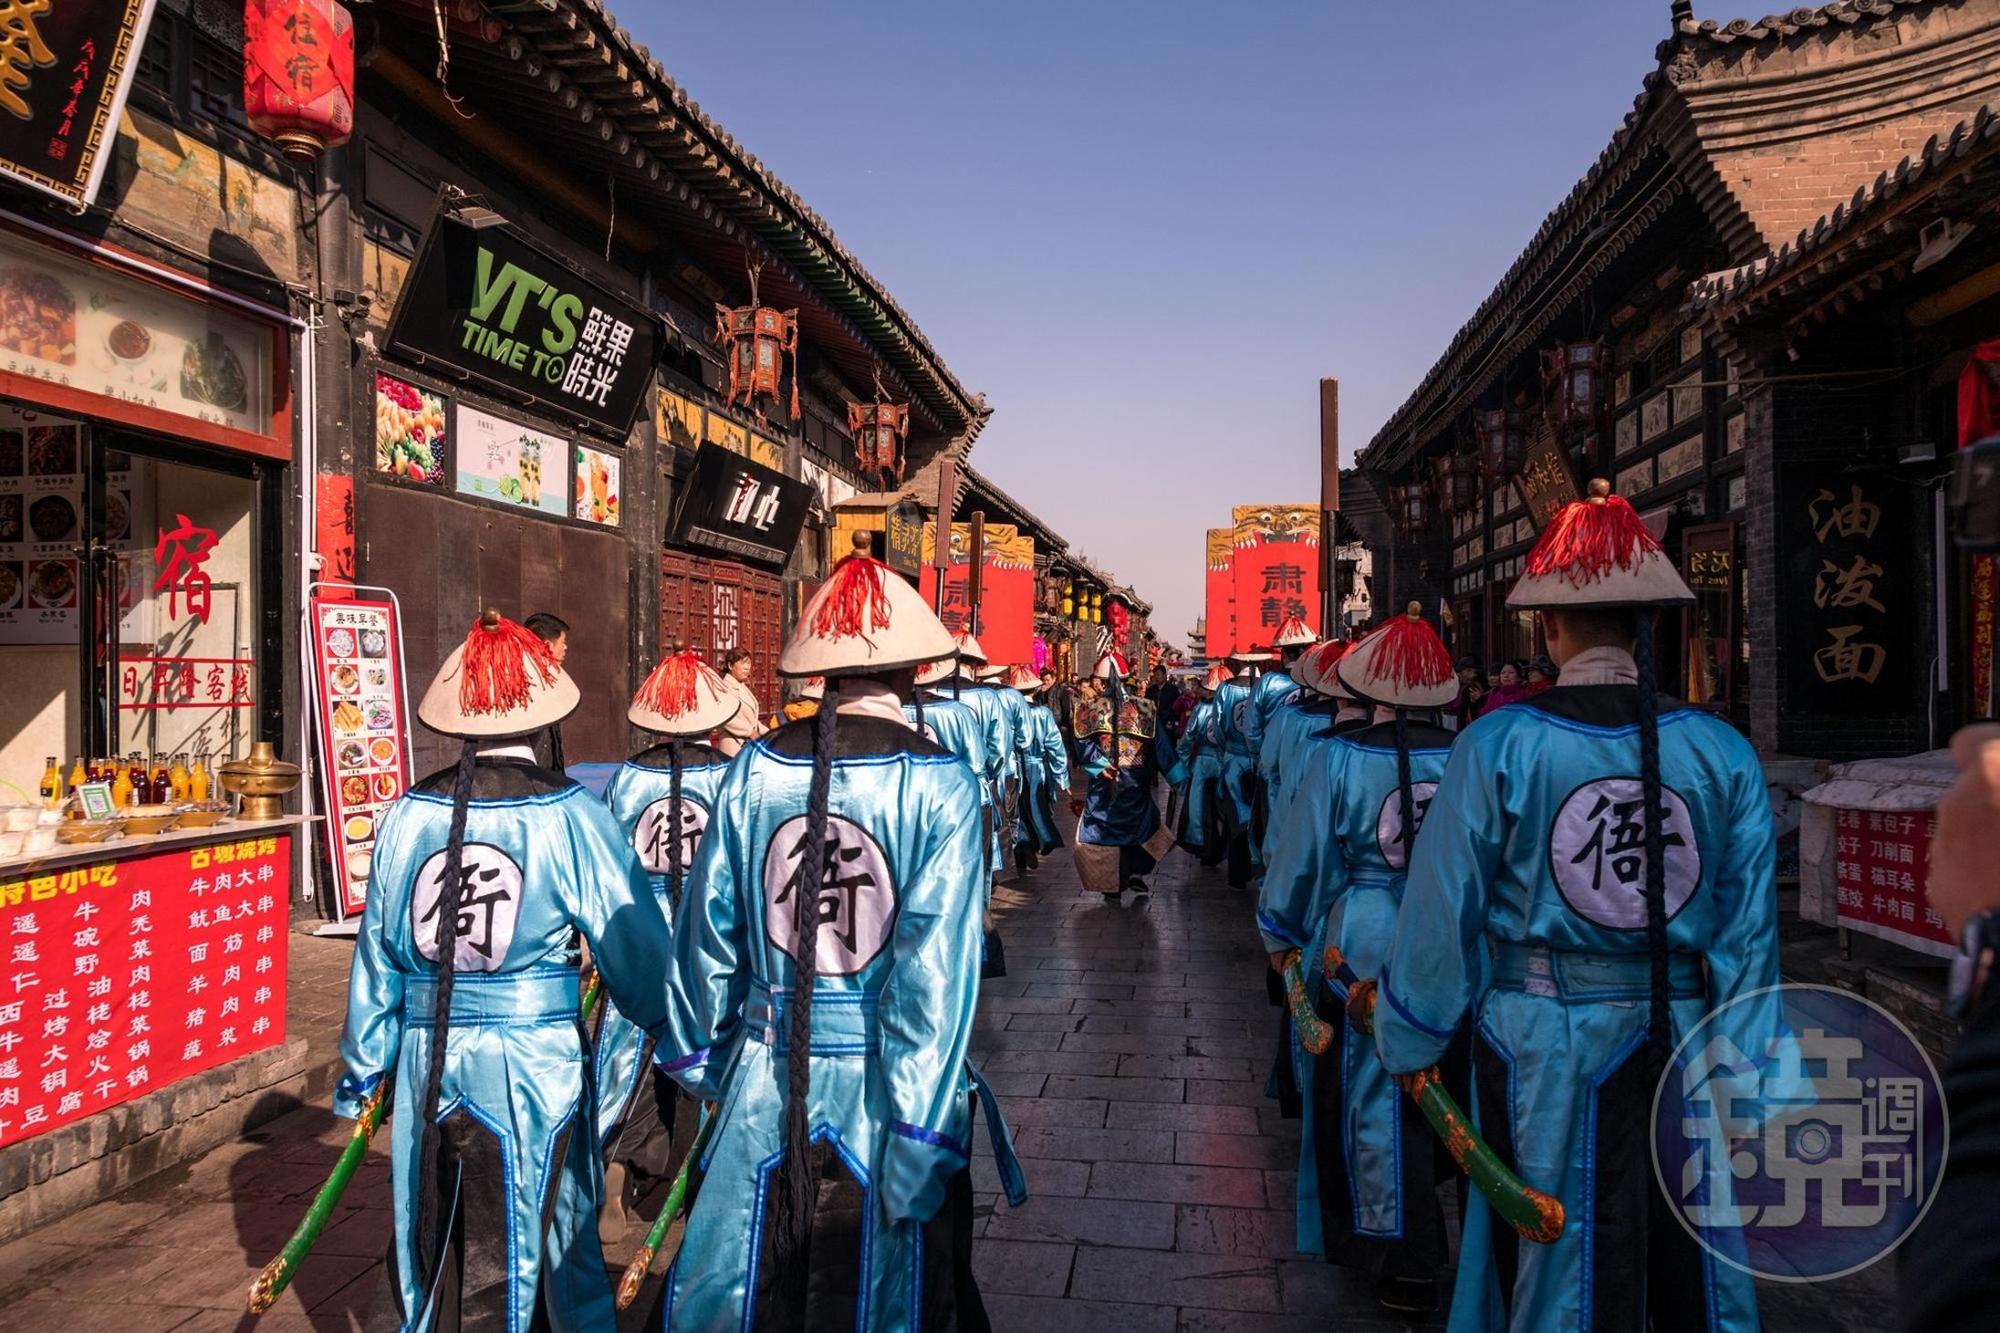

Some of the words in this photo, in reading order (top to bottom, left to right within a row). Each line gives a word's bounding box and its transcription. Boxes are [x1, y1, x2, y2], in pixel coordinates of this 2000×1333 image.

[461, 319, 531, 372] TIME
[153, 512, 220, 625] 宿
[1870, 840, 1915, 865] 刀削面
[188, 864, 275, 896] 牛肉大串
[1871, 866, 1916, 893] 猫耳朵
[187, 895, 275, 929] 鱿鱼大串
[1871, 893, 1916, 923] 牛肉面
